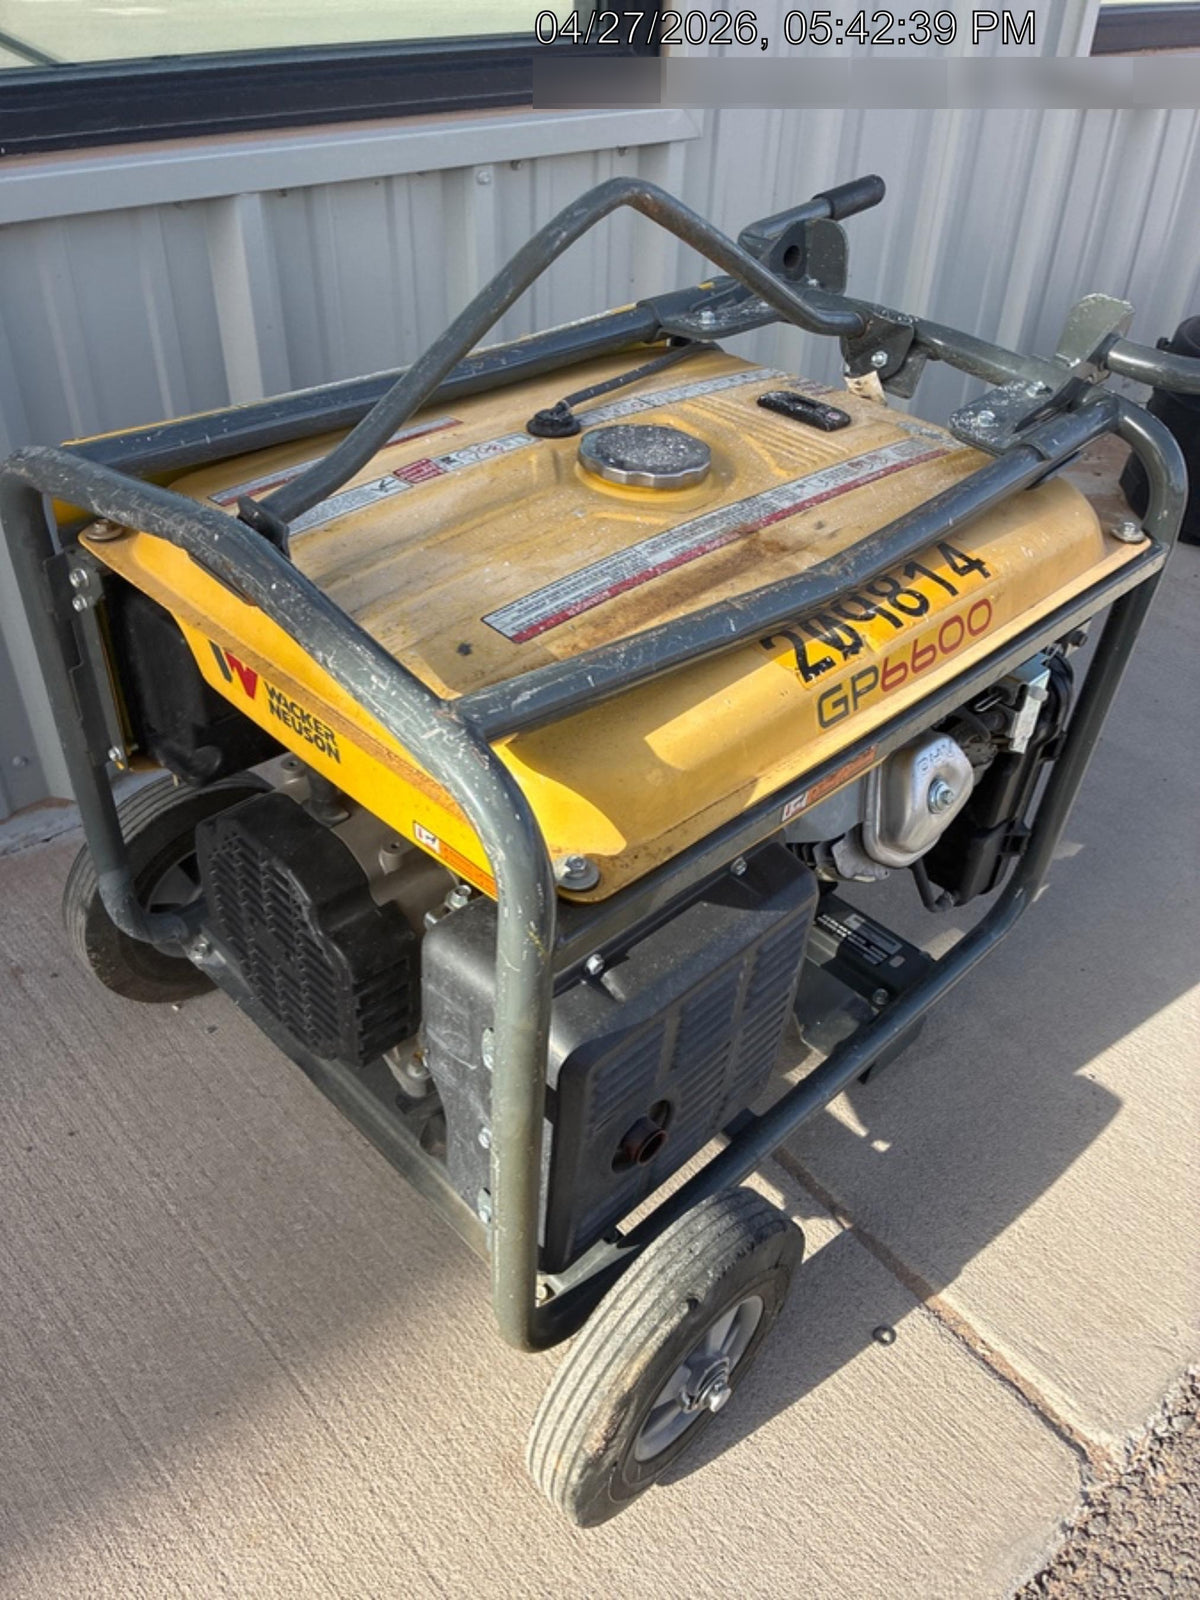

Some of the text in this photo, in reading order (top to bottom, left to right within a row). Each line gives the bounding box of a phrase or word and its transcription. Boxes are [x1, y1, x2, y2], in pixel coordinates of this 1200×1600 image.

[817, 599, 994, 730] GP6600
[264, 681, 338, 747] WACKER
[268, 703, 341, 764] NEUSON
